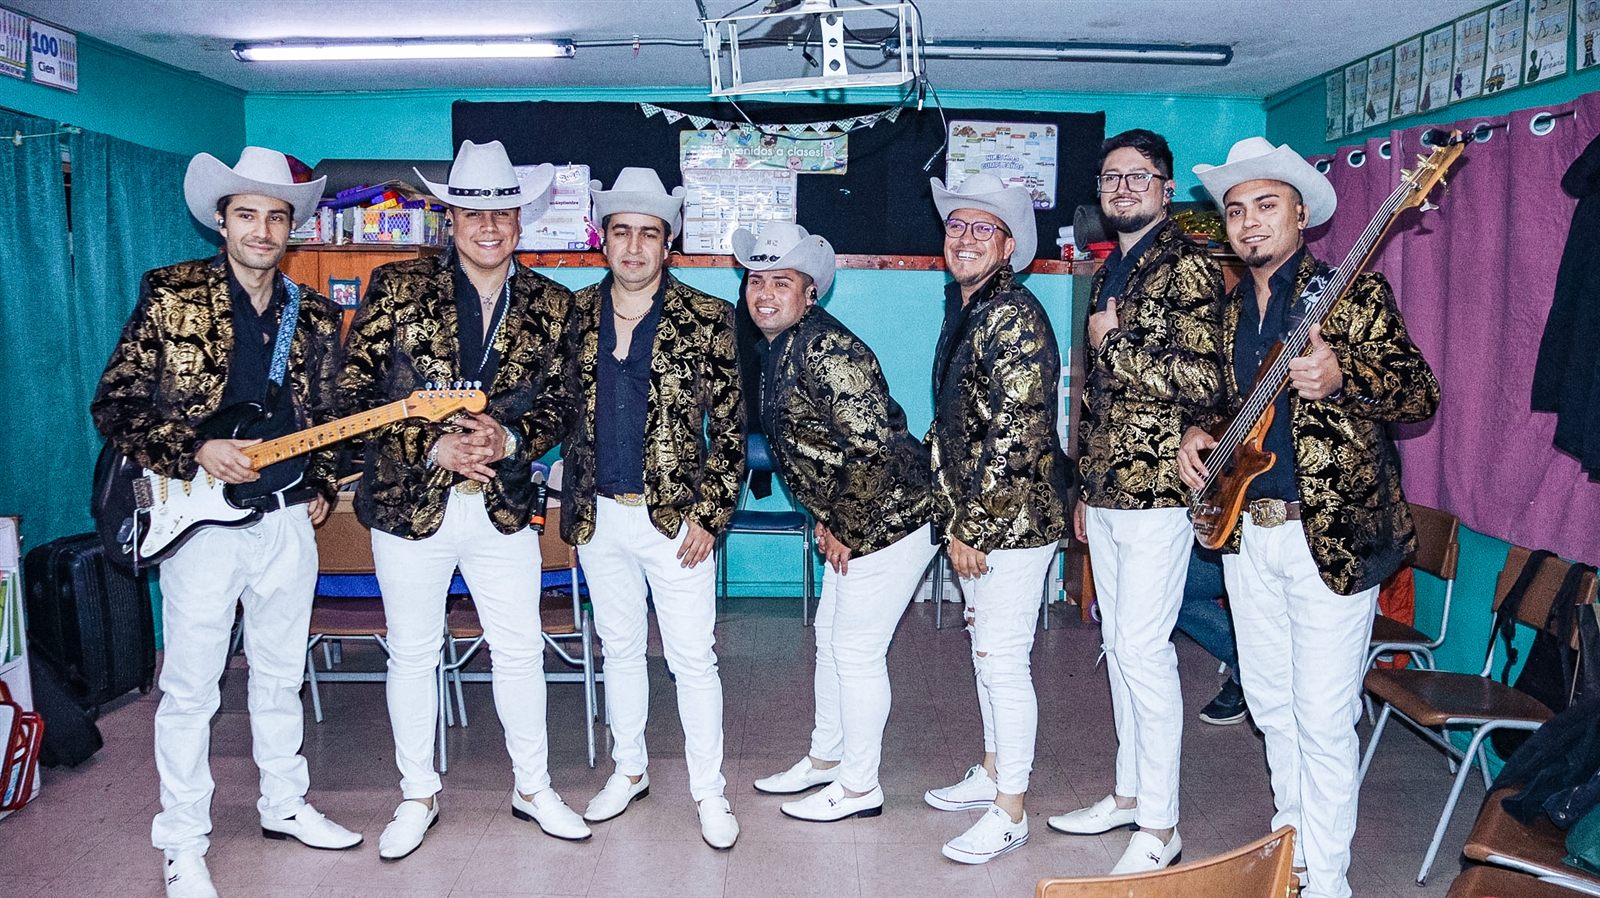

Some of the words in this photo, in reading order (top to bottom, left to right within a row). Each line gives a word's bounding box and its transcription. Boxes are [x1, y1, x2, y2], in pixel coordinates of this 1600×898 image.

[32, 31, 58, 57] 100
[38, 61, 55, 75] Cien
[776, 148, 784, 156] a
[787, 145, 824, 157] clases!
